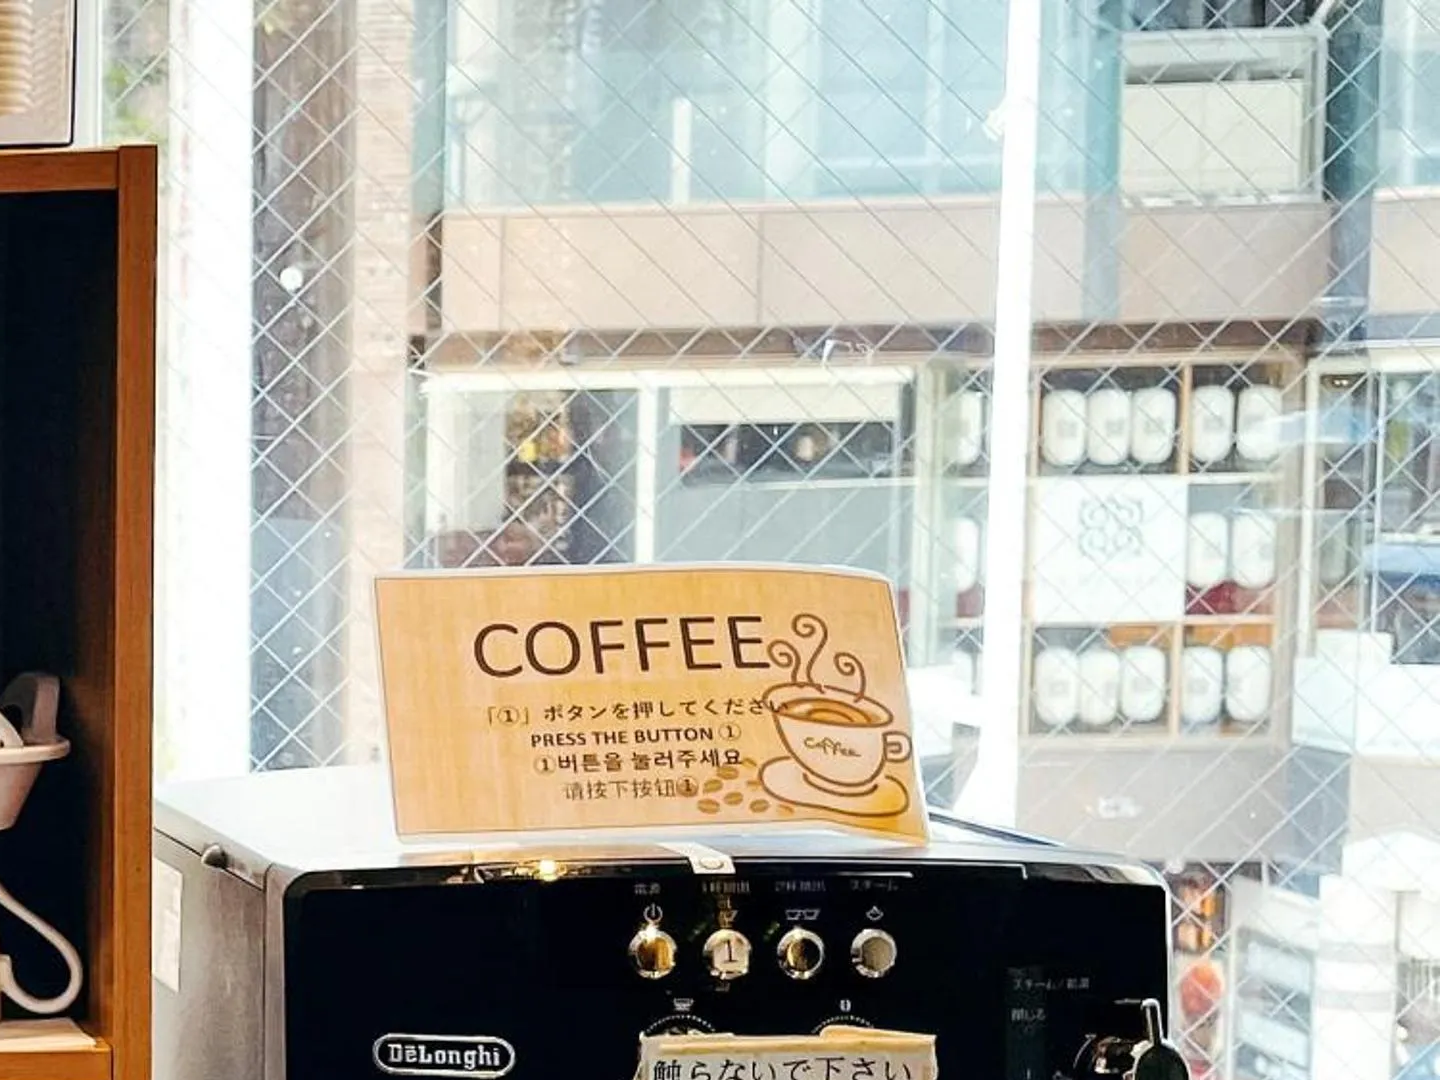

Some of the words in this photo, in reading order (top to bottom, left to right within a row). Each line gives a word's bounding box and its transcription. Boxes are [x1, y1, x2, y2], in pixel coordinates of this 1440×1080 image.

[473, 616, 771, 678] COFFEE
[531, 732, 587, 747] PRESS
[591, 731, 629, 745] THE
[635, 727, 714, 743] BUTTON
[631, 748, 742, 770] 눌러주세요
